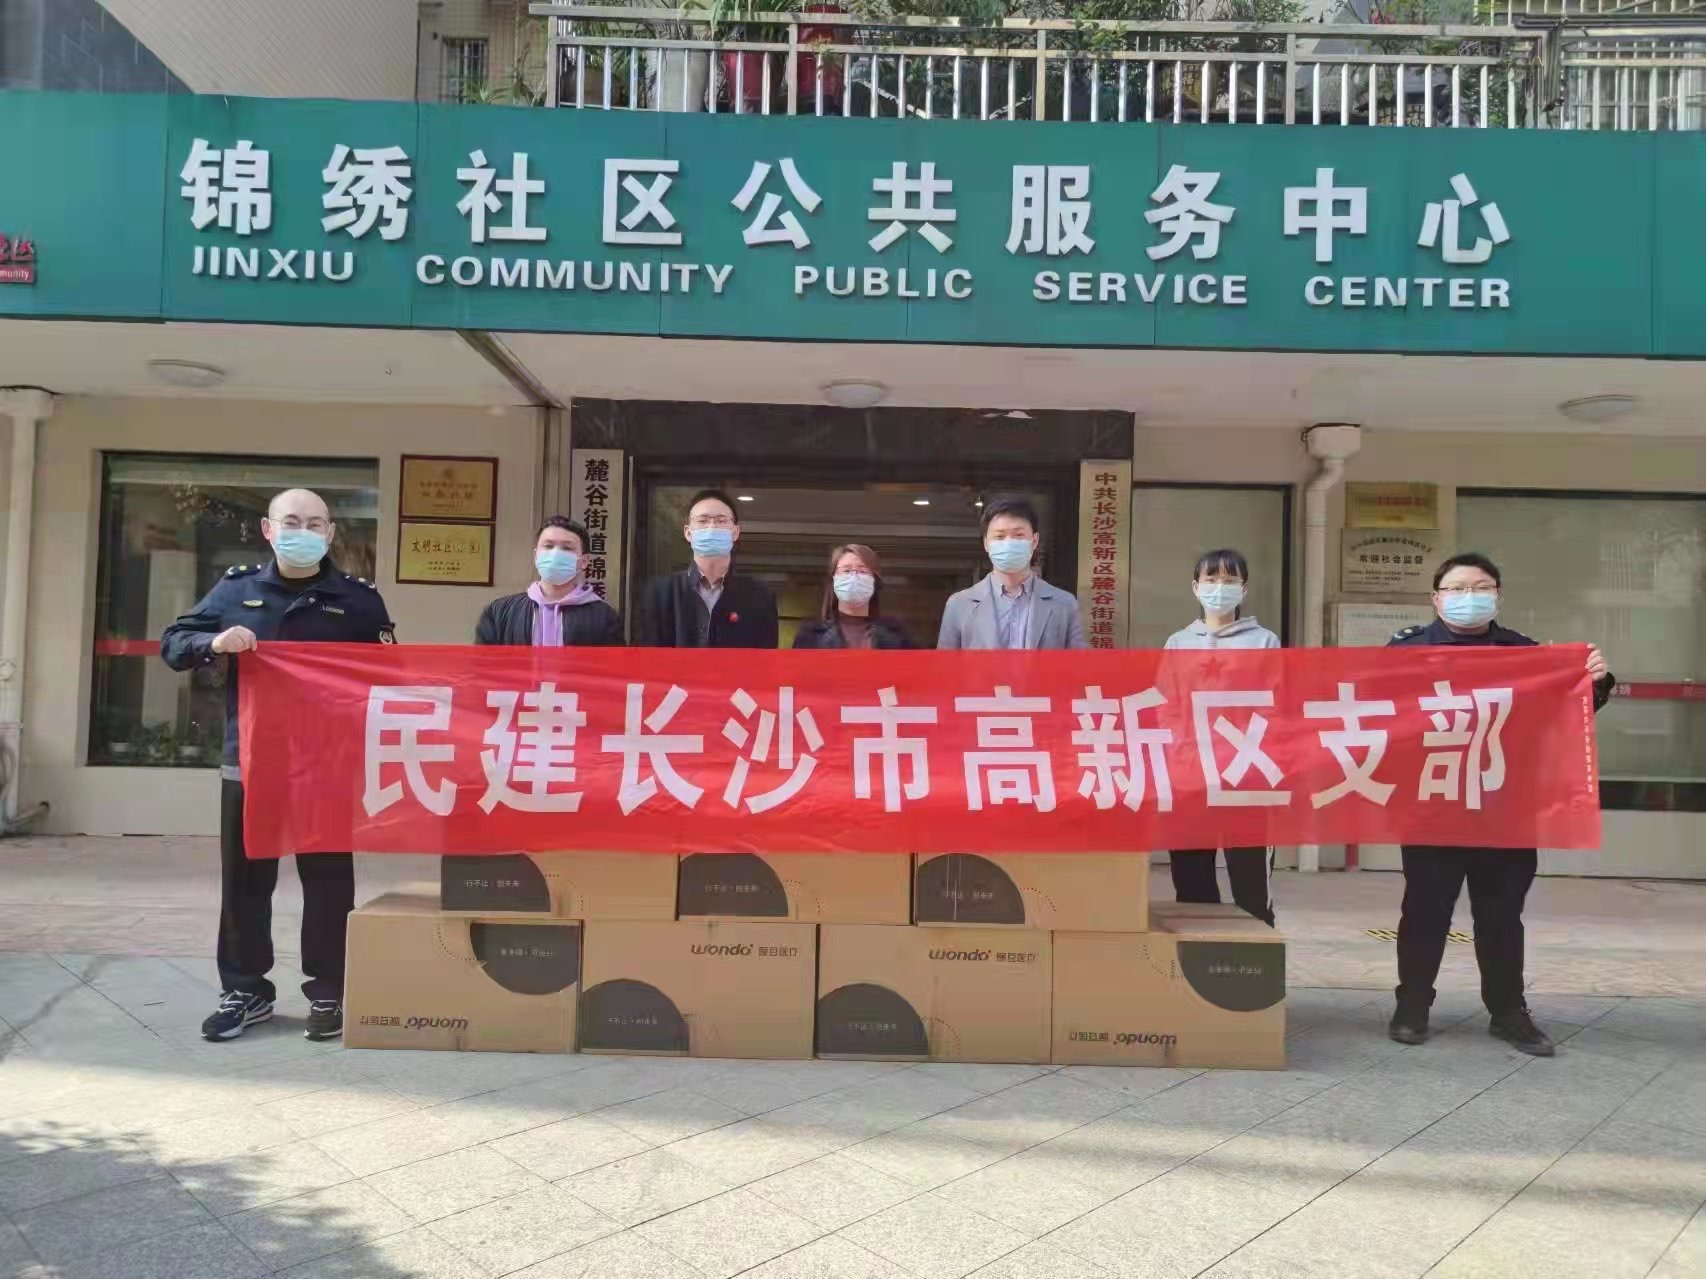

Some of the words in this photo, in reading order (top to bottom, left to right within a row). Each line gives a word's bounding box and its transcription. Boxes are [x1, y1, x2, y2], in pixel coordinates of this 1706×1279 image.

[180, 138, 1511, 264] 锦绣社区公共服务中心
[192, 246, 355, 282] JINXIU
[416, 255, 734, 294] COMMUNITY
[795, 265, 973, 300] PUBLIC
[1032, 270, 1248, 306] SERVICE
[1304, 275, 1511, 310] CENTER
[361, 681, 1514, 817] 民建长沙市高新区支部
